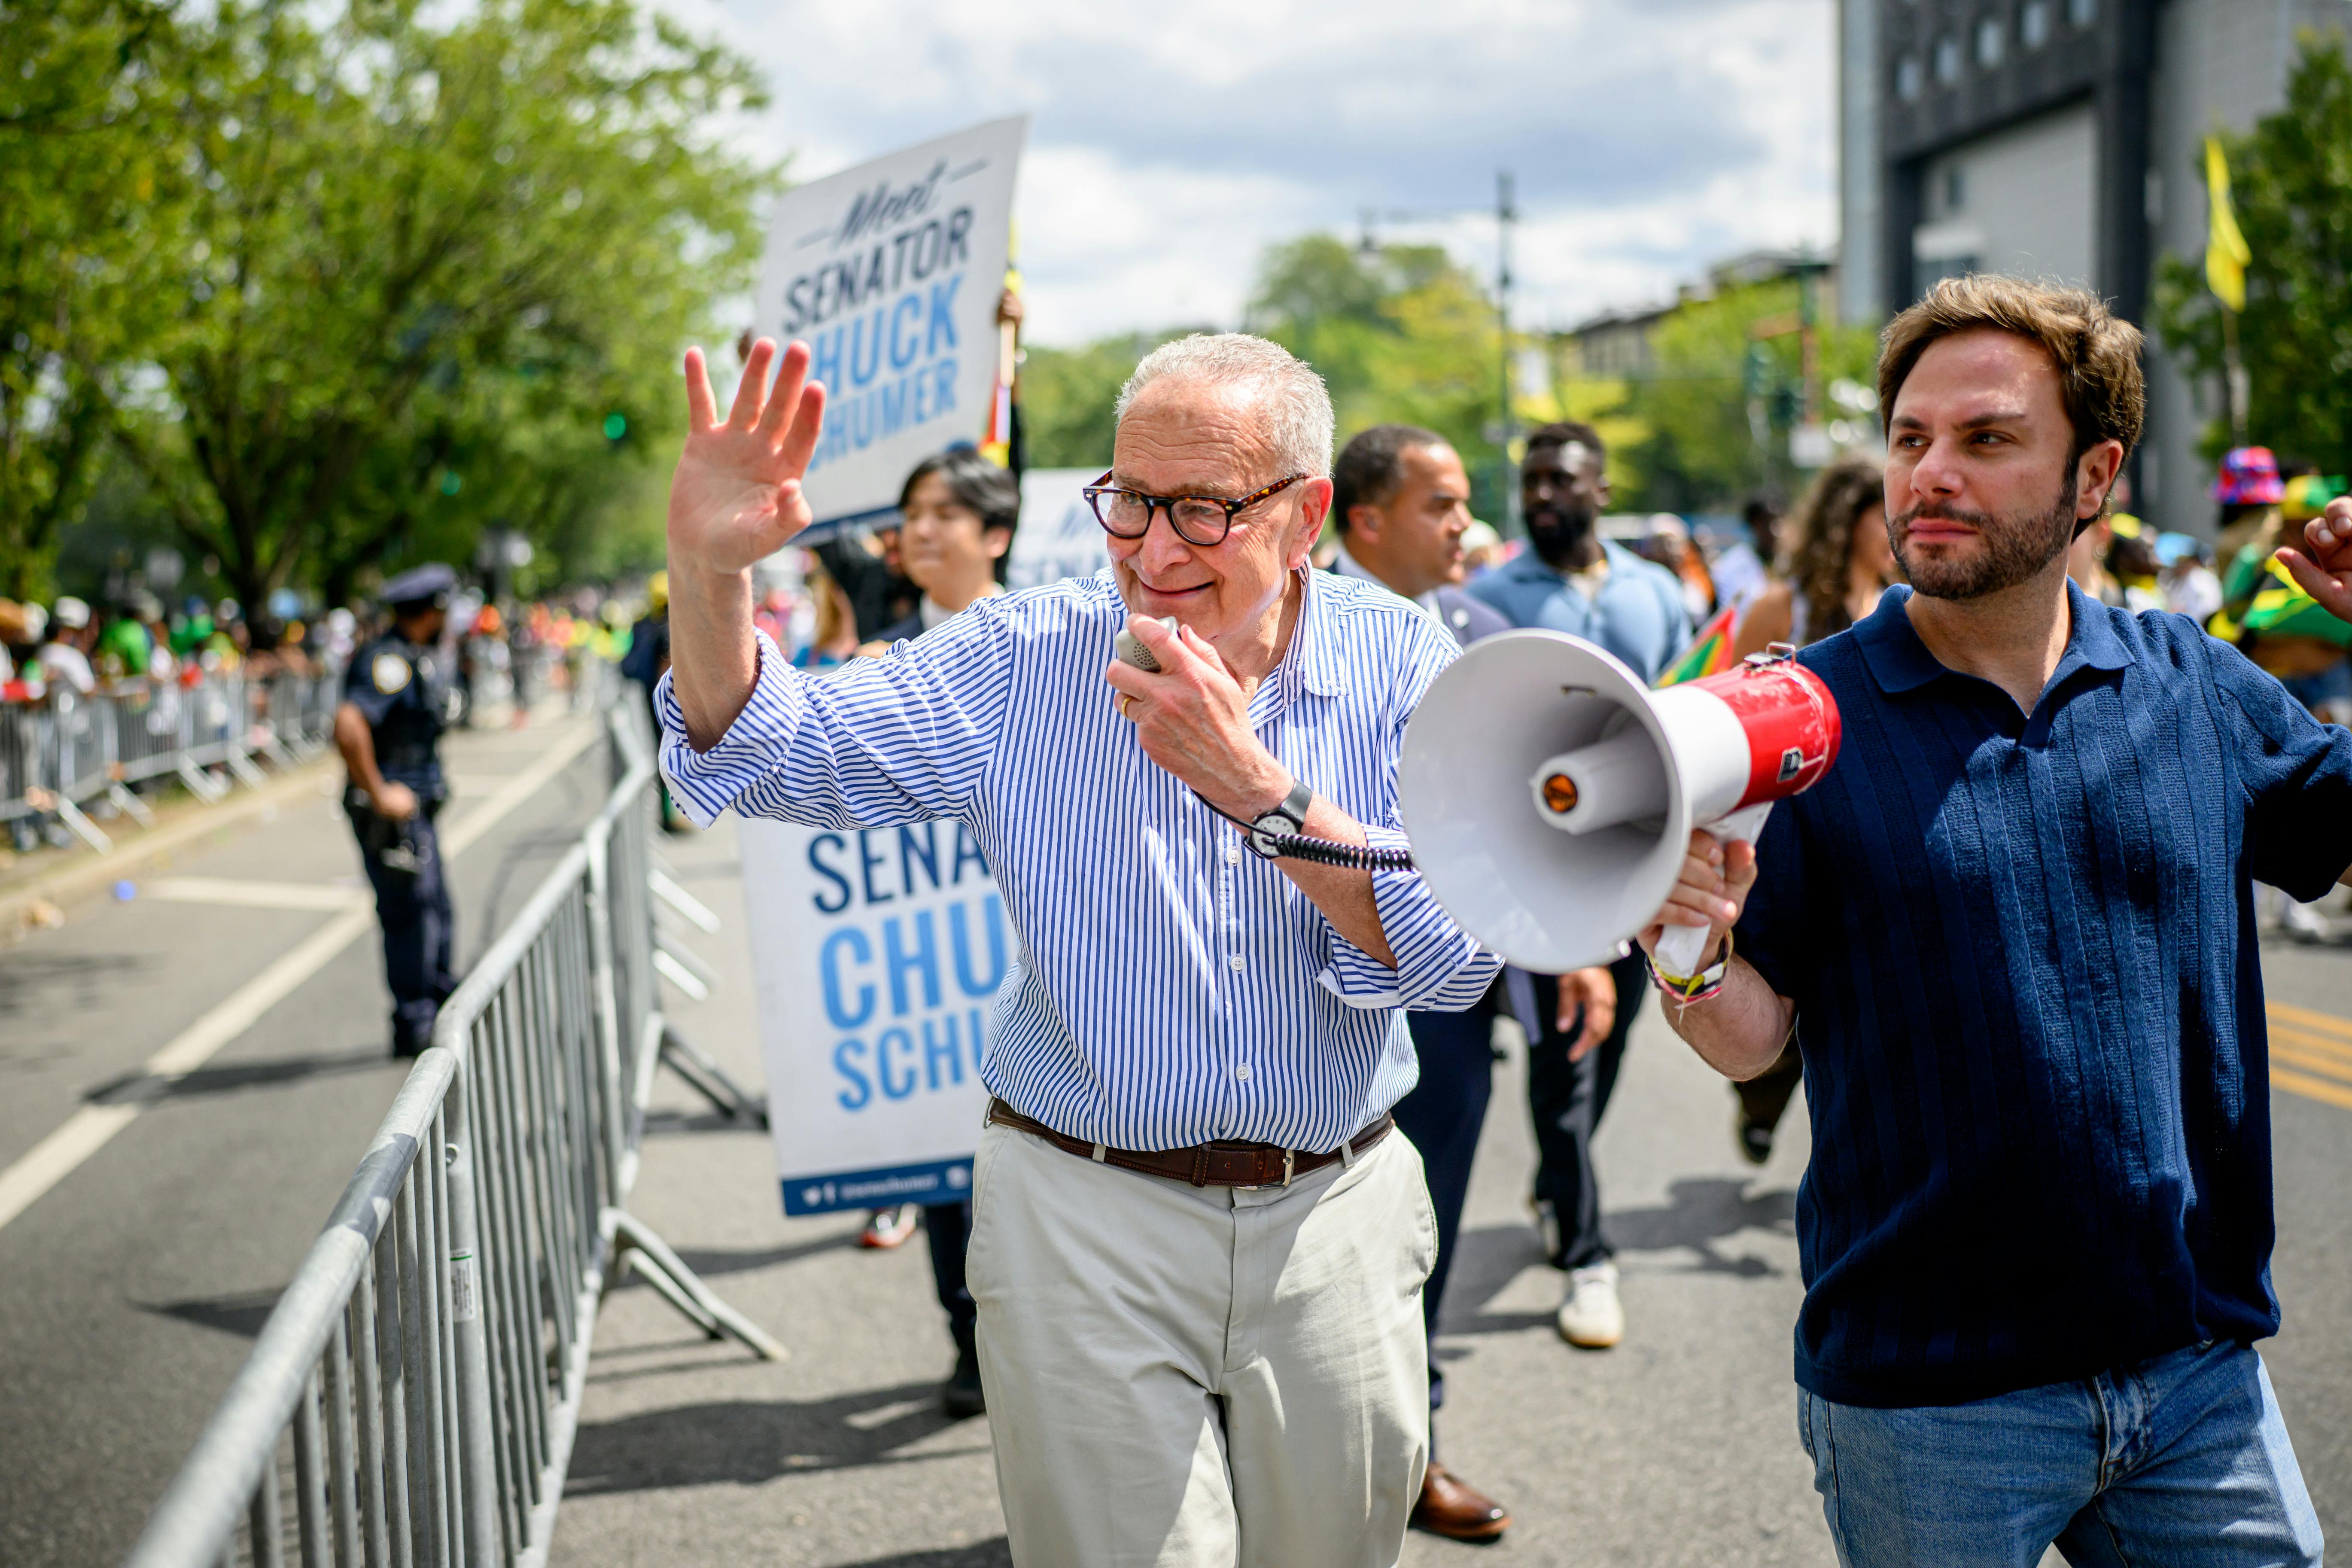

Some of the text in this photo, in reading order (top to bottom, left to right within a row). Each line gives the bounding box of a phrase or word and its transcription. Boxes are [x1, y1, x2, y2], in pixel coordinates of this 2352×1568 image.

[831, 156, 947, 250] Meet
[782, 204, 975, 335] SENATOR
[814, 271, 963, 398] HUCK
